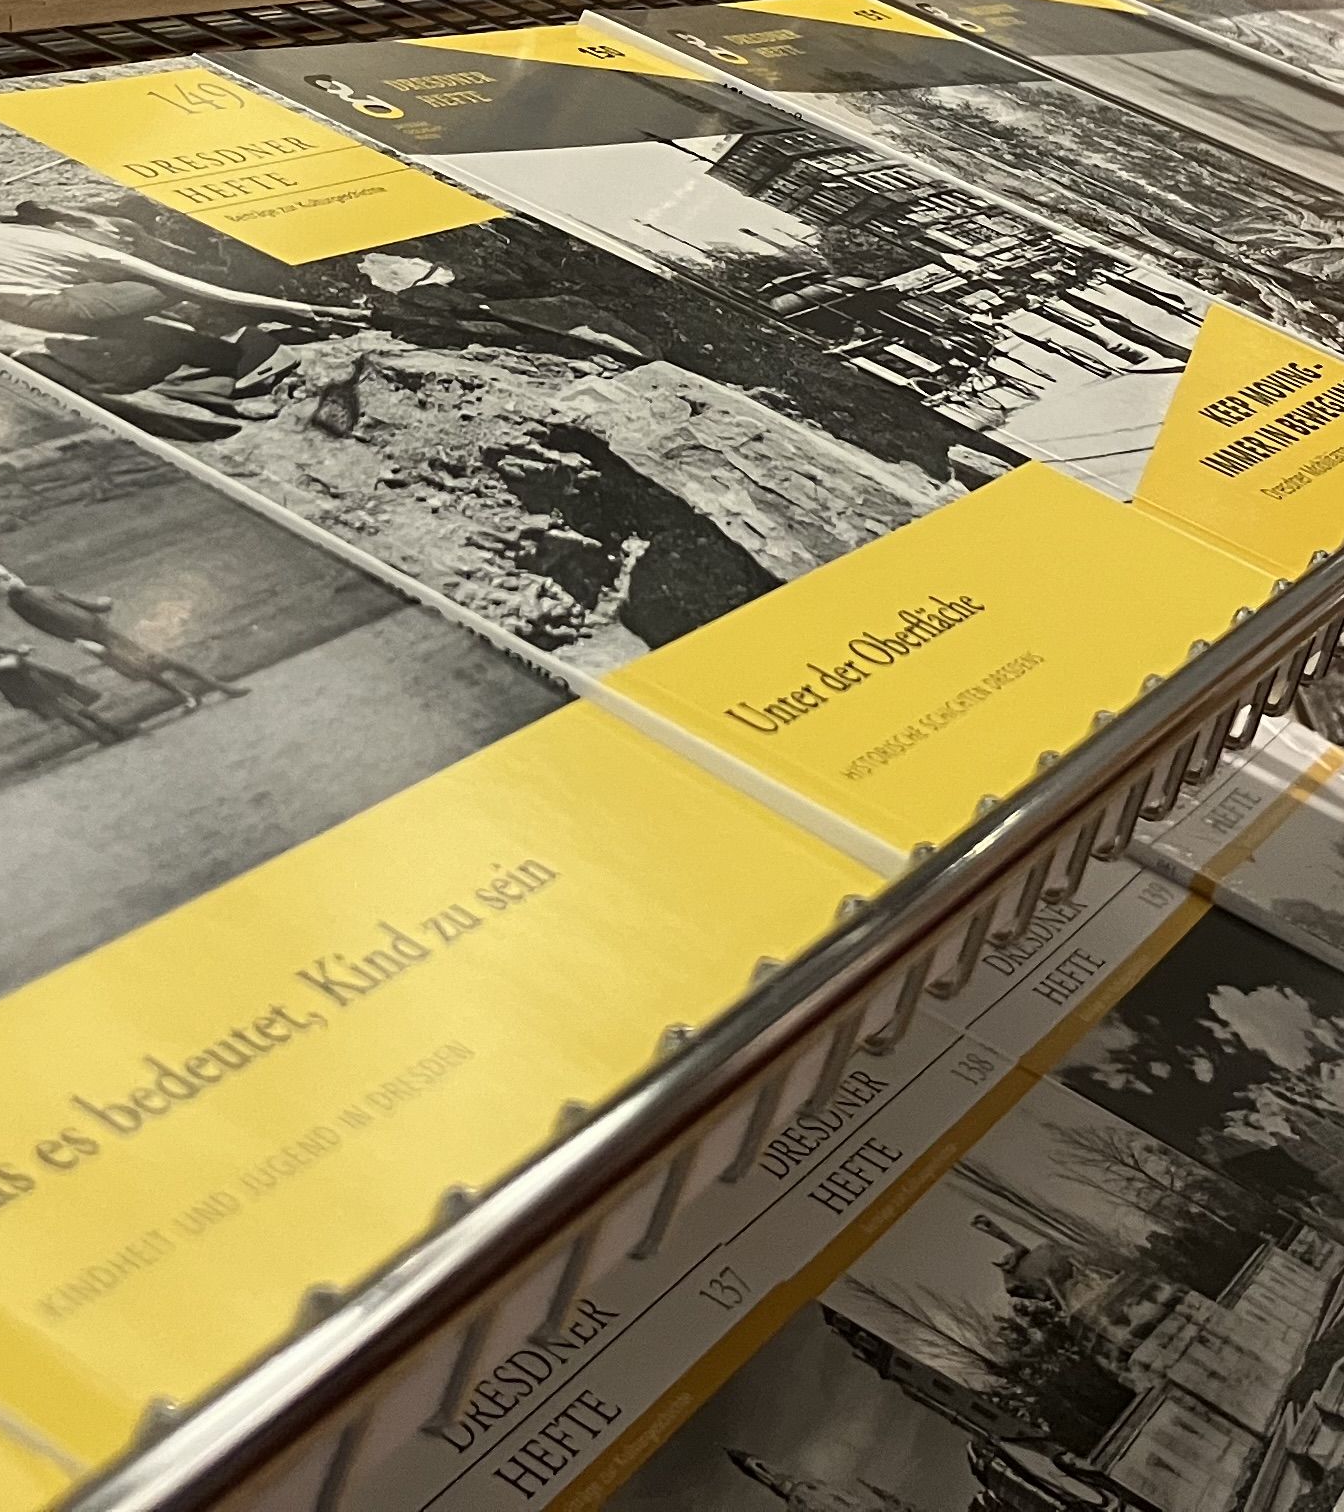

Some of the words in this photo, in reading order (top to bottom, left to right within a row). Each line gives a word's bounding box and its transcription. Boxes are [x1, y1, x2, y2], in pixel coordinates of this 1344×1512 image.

[853, 9, 893, 22] 151
[381, 71, 498, 91] DRESDNER
[578, 45, 625, 60] 150
[147, 80, 247, 117] 149
[415, 90, 493, 109] HEFTE
[123, 135, 319, 180] DRESDNER
[172, 172, 299, 204] HEFTE
[1198, 396, 1258, 428] KEEP
[1237, 362, 1322, 407] MOVING
[1199, 436, 1282, 478] IMMER
[1254, 424, 1300, 448] IN
[723, 684, 829, 735] Unter
[807, 660, 872, 693] der
[848, 594, 985, 666] Oberfläche
[842, 725, 929, 781] HISTORISCHE
[919, 679, 991, 732] SCHICHTEN
[983, 899, 1090, 976] DRESDNER
[1032, 947, 1105, 1006] HEFTE
[35, 1127, 102, 1172] es
[72, 999, 331, 1142] bedeutet,
[297, 920, 432, 1009] Kind
[422, 900, 483, 944] zu
[475, 855, 562, 911] sein
[952, 1049, 1000, 1089] 138
[761, 1069, 889, 1180] DRESDNER
[36, 1228, 178, 1326] KINDHEIT
[174, 1189, 241, 1241] UND
[241, 1124, 342, 1203] JUGEND
[341, 1102, 372, 1130] IN
[370, 1039, 478, 1114] DRESDEN
[808, 1136, 903, 1214] HEFTE
[699, 1265, 753, 1313] 137
[442, 1298, 621, 1453] DRESDNER
[493, 1389, 622, 1500] HEFTE
